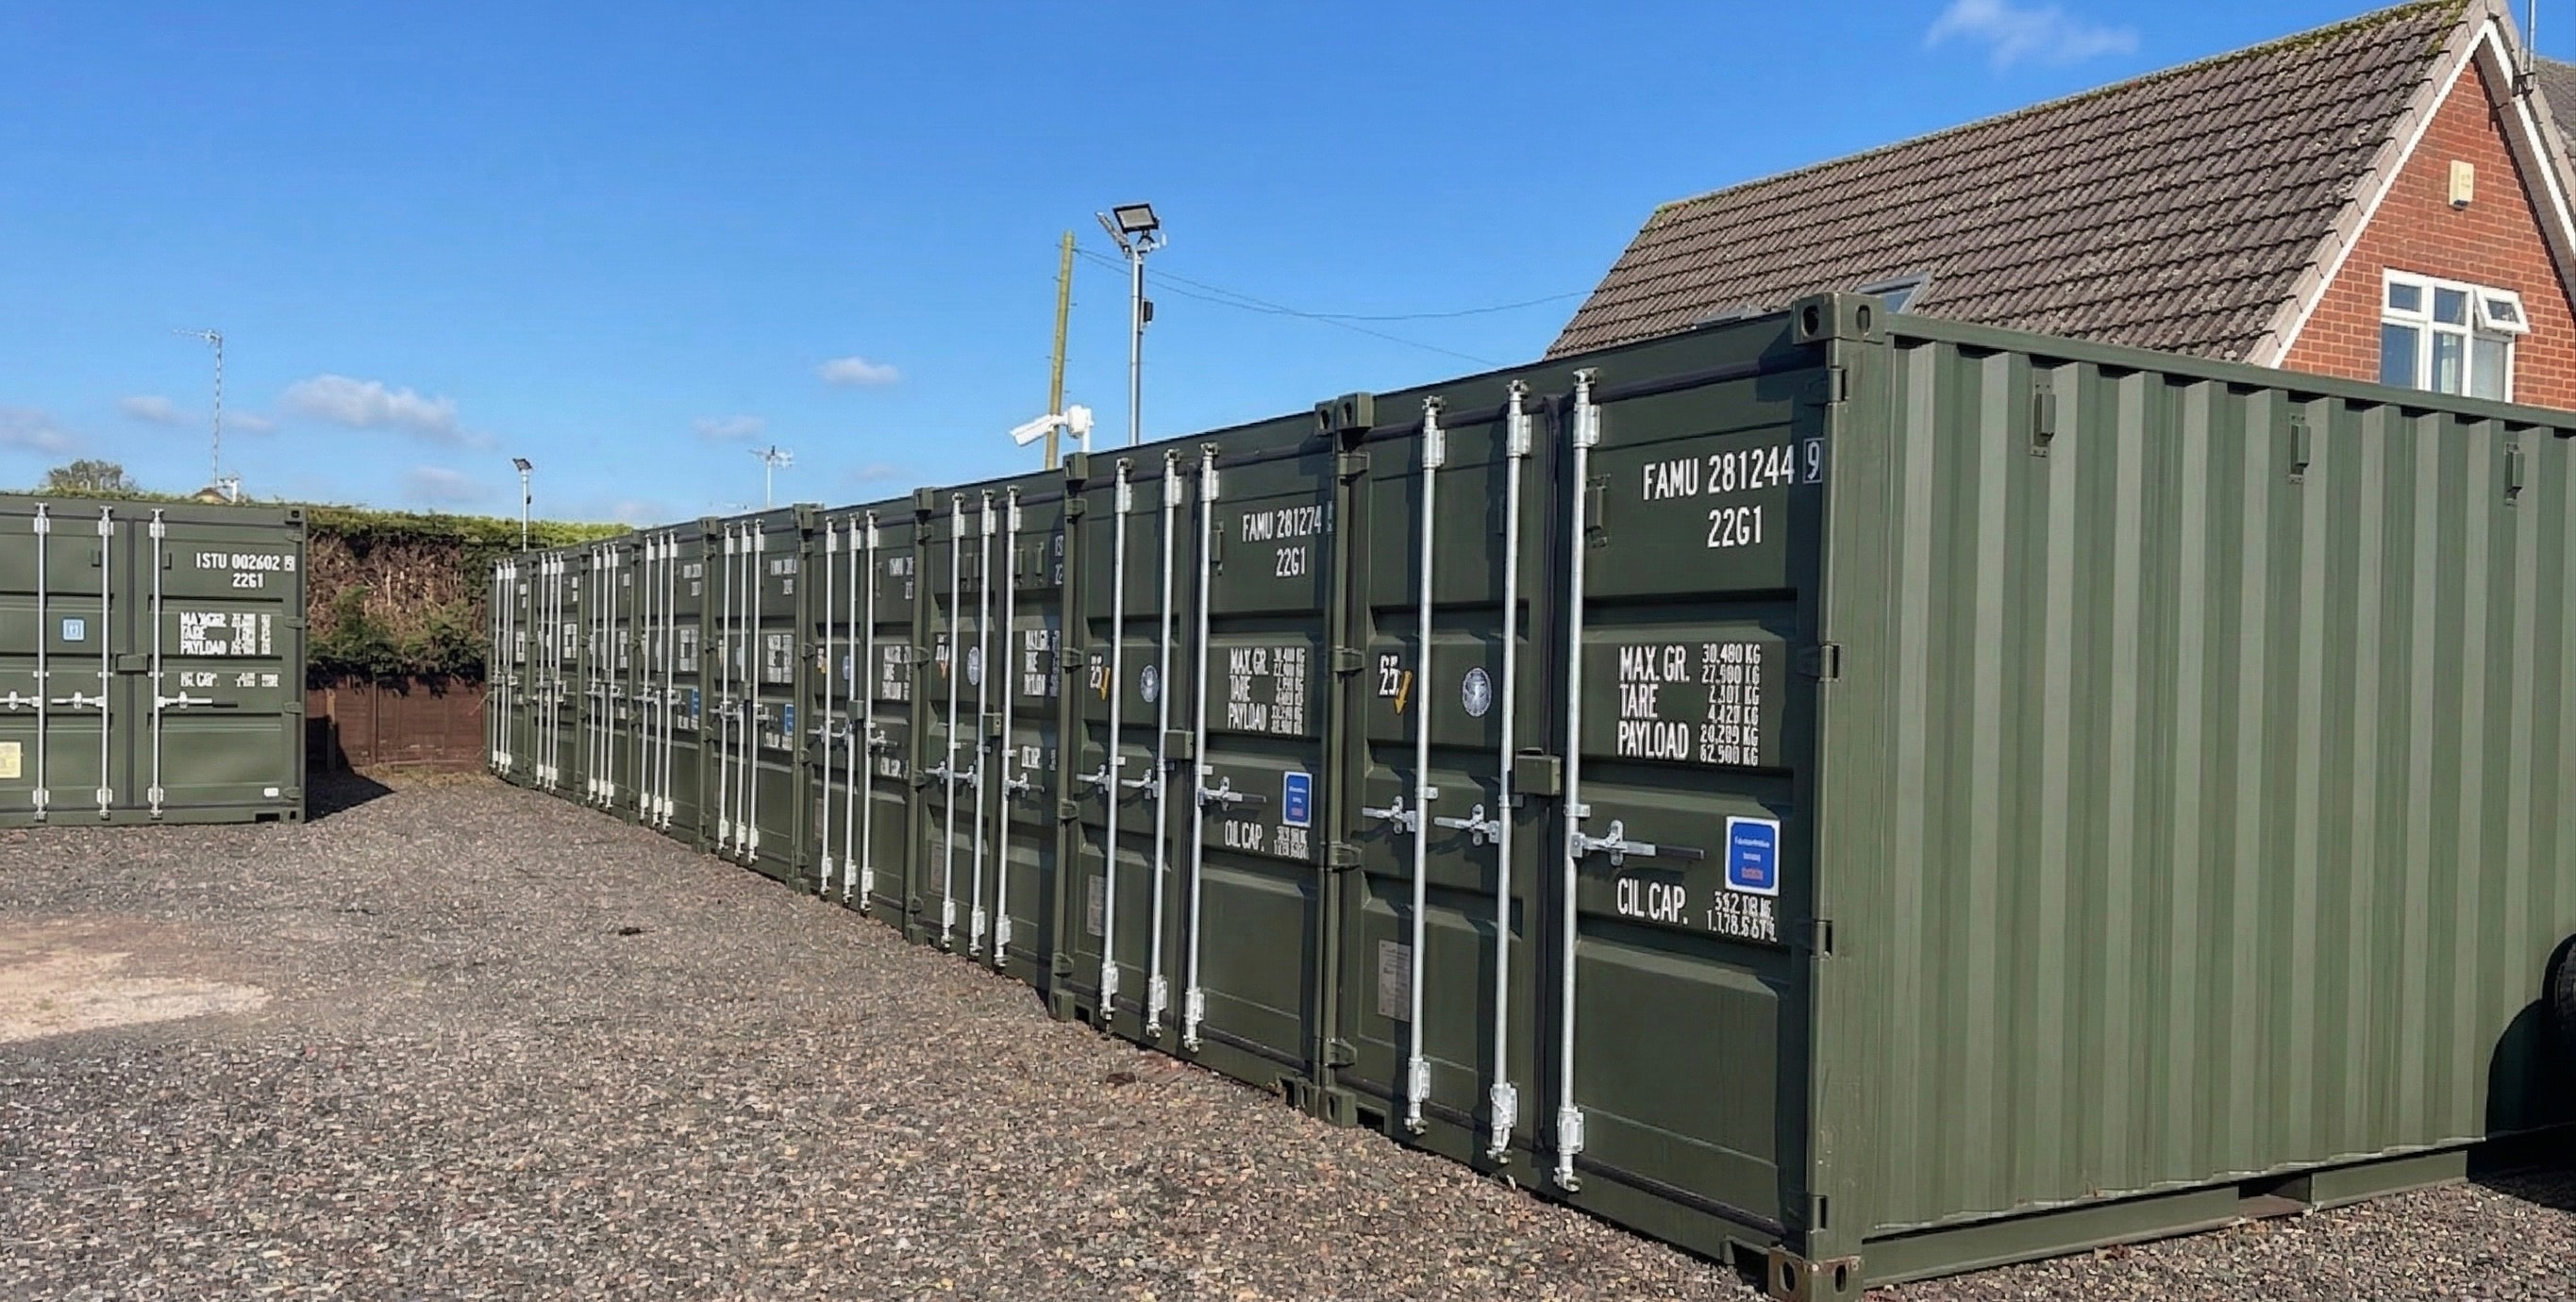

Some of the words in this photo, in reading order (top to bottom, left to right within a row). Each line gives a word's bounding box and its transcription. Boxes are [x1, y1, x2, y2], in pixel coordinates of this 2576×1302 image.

[1643, 458, 1698, 500] FAMU
[1707, 444, 1795, 493] 281244
[1806, 440, 1821, 481] 9
[1242, 511, 1274, 542] FAMU
[1277, 505, 1322, 539] 281274
[1707, 505, 1763, 548] 22G1
[195, 552, 227, 569] ISTU
[231, 554, 280, 571] 002602
[1276, 546, 1306, 576] 22G1
[1619, 645, 1661, 681] MAX.
[1663, 644, 1690, 682] GR.
[1745, 643, 1761, 663] KG
[1619, 683, 1659, 718] TARE
[1617, 720, 1690, 760] PAYLOAD
[1242, 822, 1265, 852] CAP.
[1648, 882, 1689, 925] CAP.
